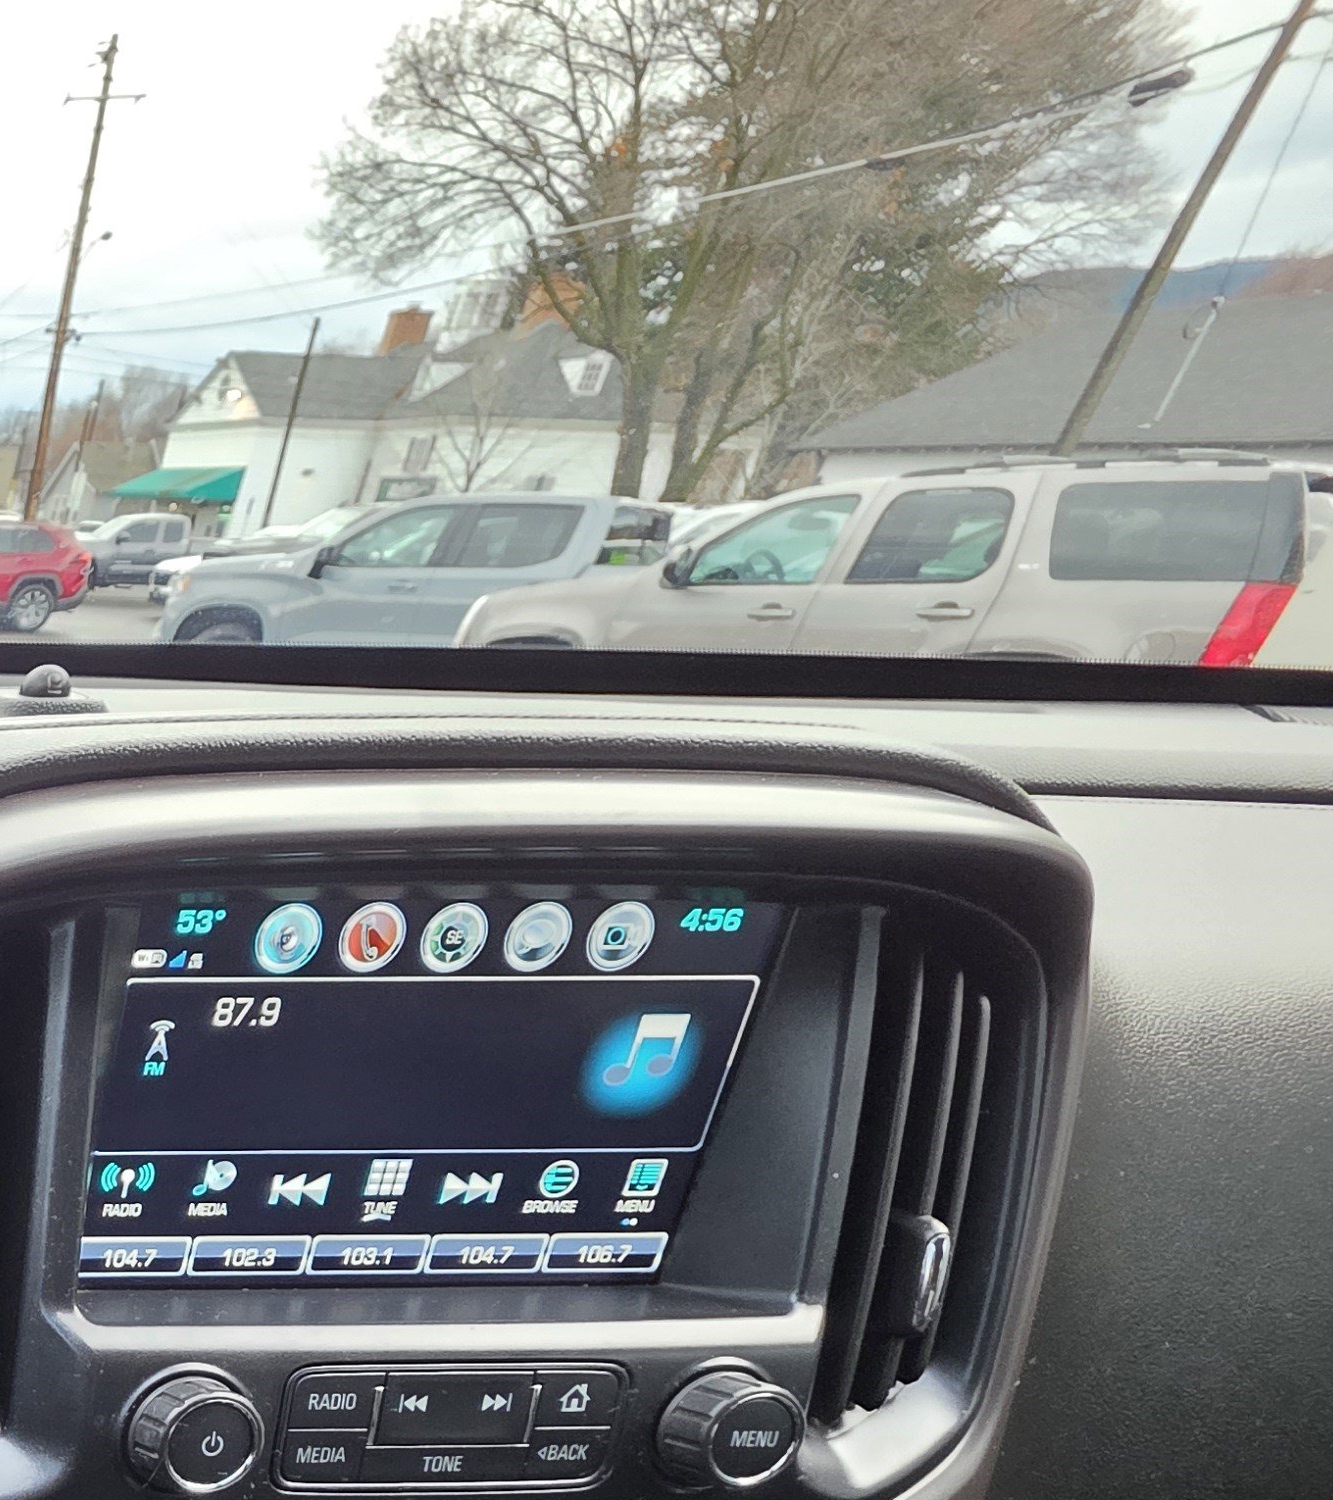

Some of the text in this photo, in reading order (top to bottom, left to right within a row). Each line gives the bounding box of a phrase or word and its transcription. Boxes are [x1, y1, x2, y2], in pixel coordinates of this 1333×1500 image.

[679, 908, 744, 932] 4:56
[211, 996, 282, 1028] 87.9
[143, 1062, 165, 1077] FM
[101, 1203, 142, 1218] RADIO
[187, 1203, 227, 1217] MEDIA
[363, 1201, 398, 1215] TUNE
[521, 1200, 579, 1214] BROWSE
[614, 1199, 655, 1213] MENU
[102, 1248, 158, 1268] 104.7
[221, 1248, 277, 1267] 102.3
[341, 1247, 393, 1266] 103.1
[459, 1246, 515, 1265] 104.7
[577, 1245, 633, 1264] 106.7
[308, 1393, 357, 1410] RADIO
[730, 1429, 780, 1448] MENU
[296, 1446, 346, 1464] MEDIA
[547, 1444, 590, 1461] BACK
[423, 1455, 464, 1473] TONE
